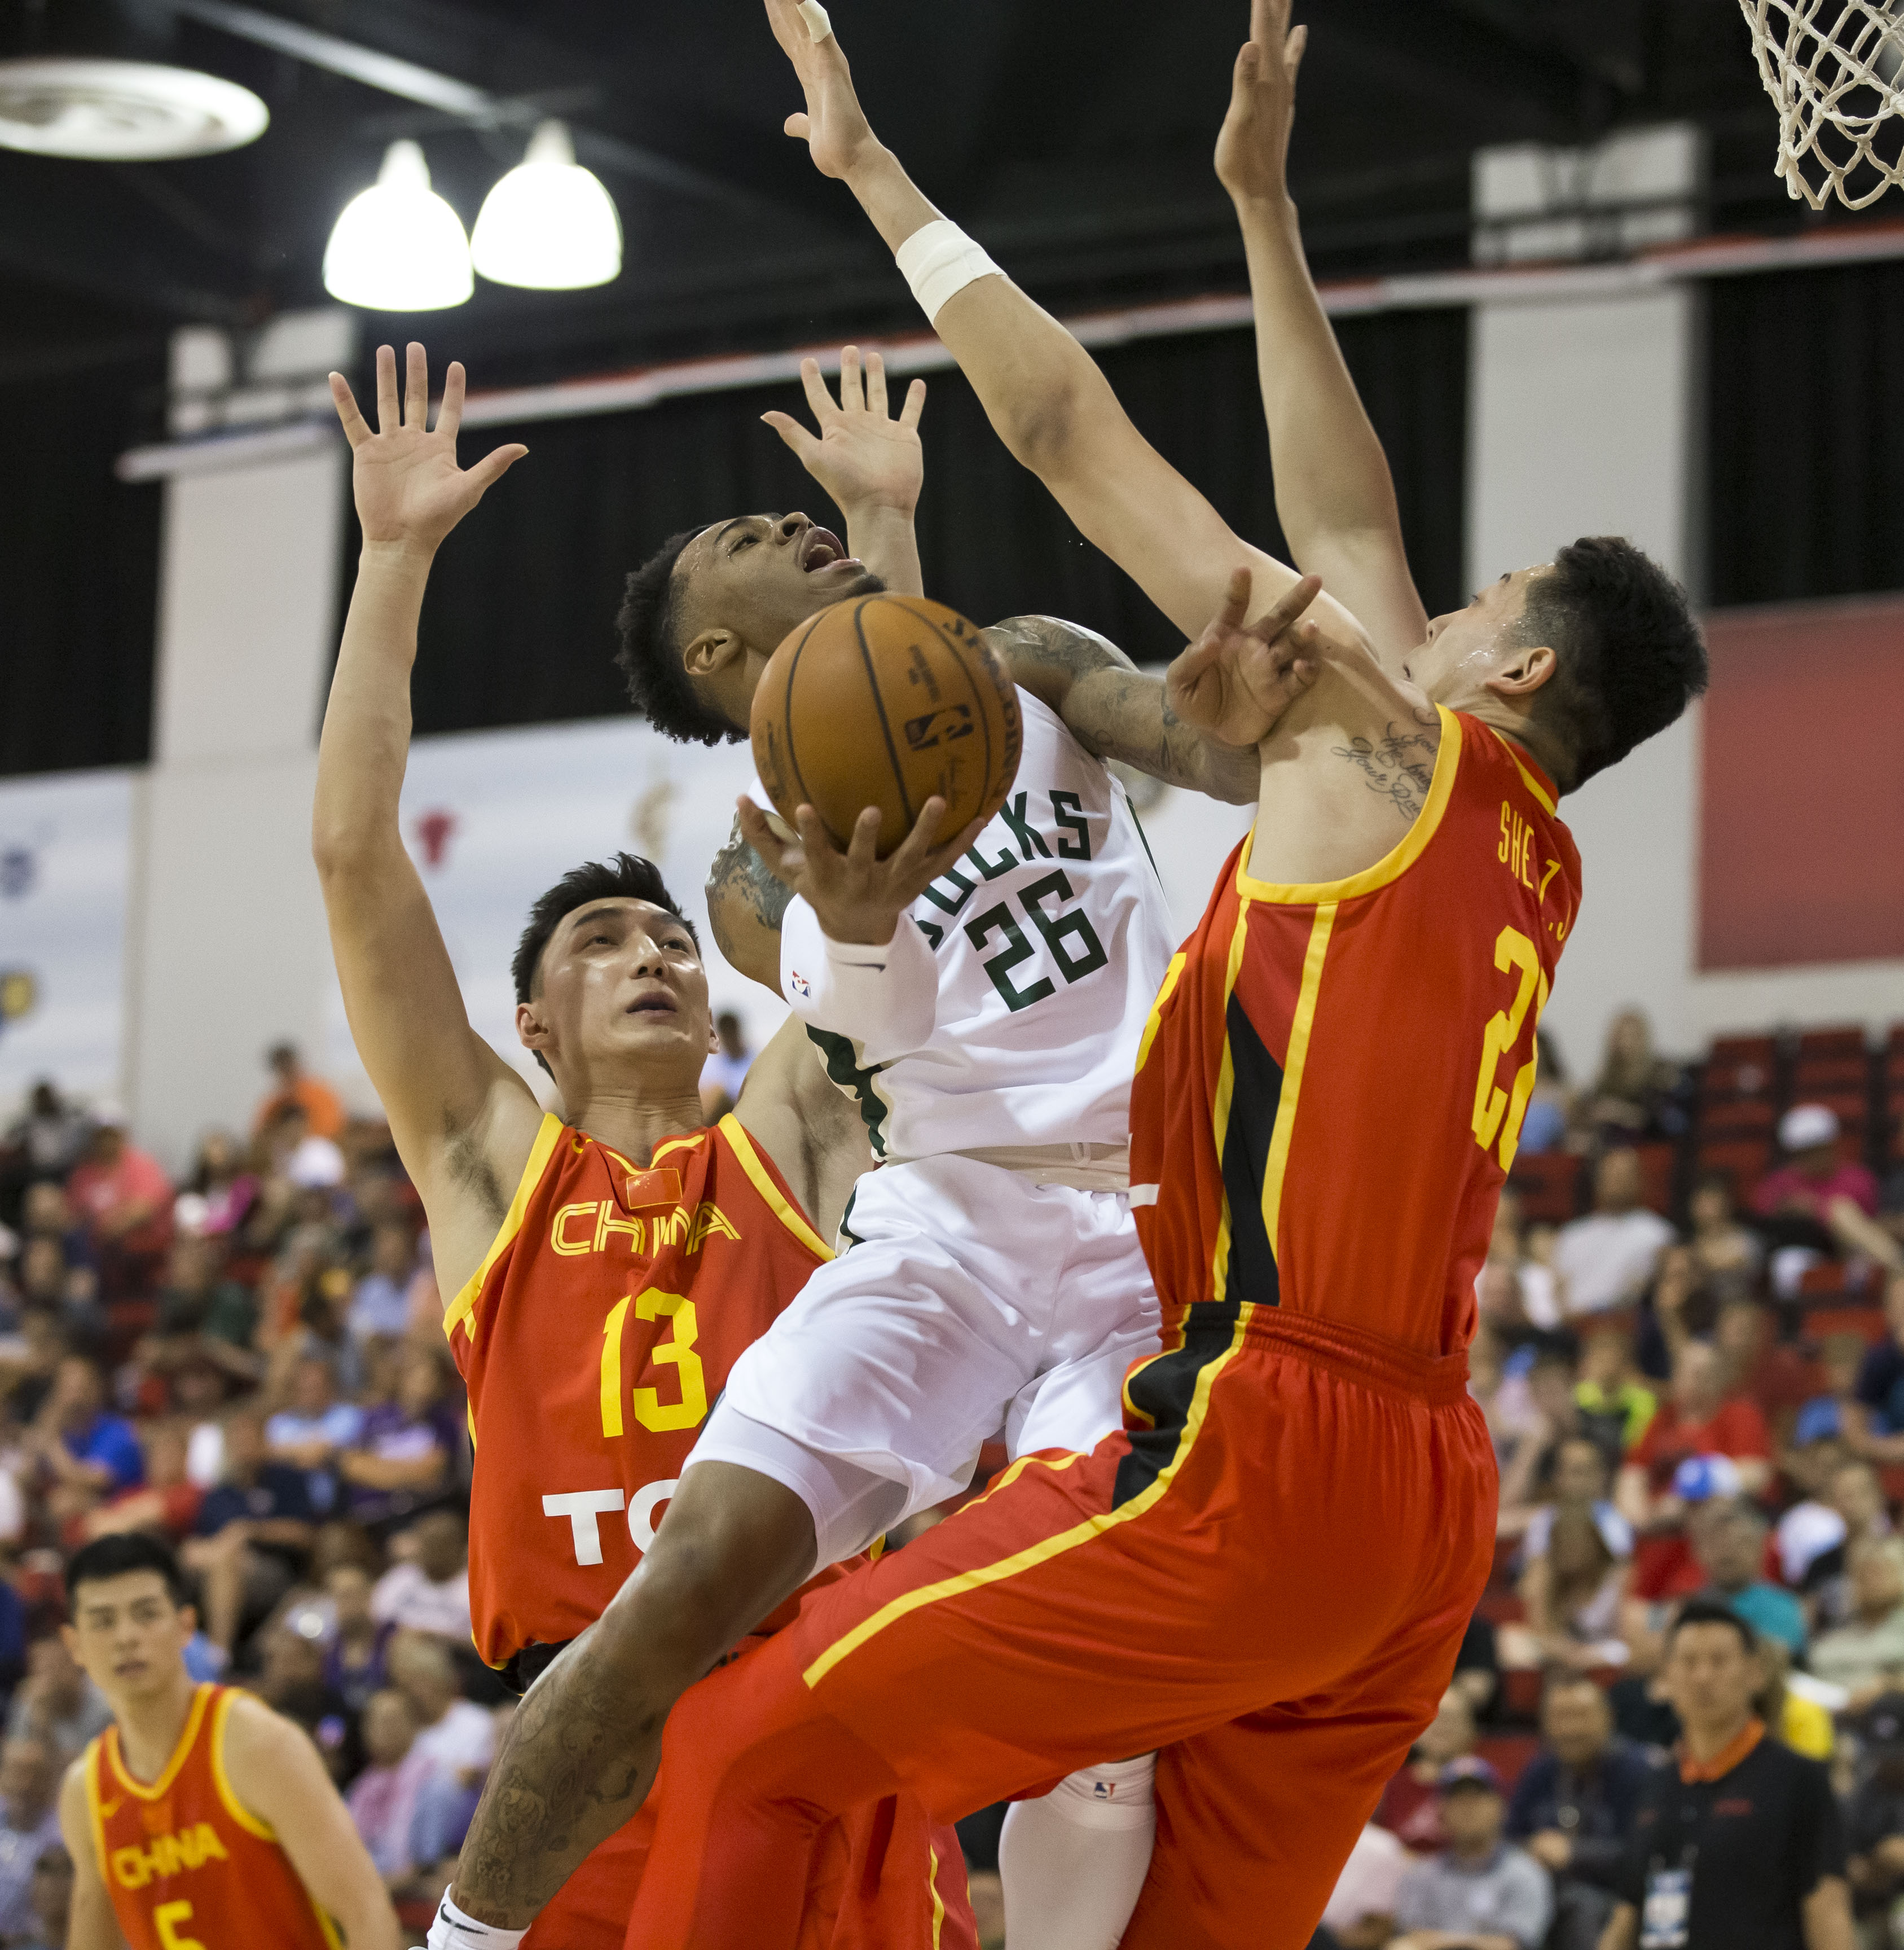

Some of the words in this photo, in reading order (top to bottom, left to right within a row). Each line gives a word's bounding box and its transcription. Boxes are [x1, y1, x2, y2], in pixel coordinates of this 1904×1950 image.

[1497, 800, 1536, 890] SHE
[963, 868, 1109, 1012] 26
[551, 1200, 742, 1258] CHINA
[600, 1286, 707, 1438] 13
[112, 1822, 230, 1888] CHINA
